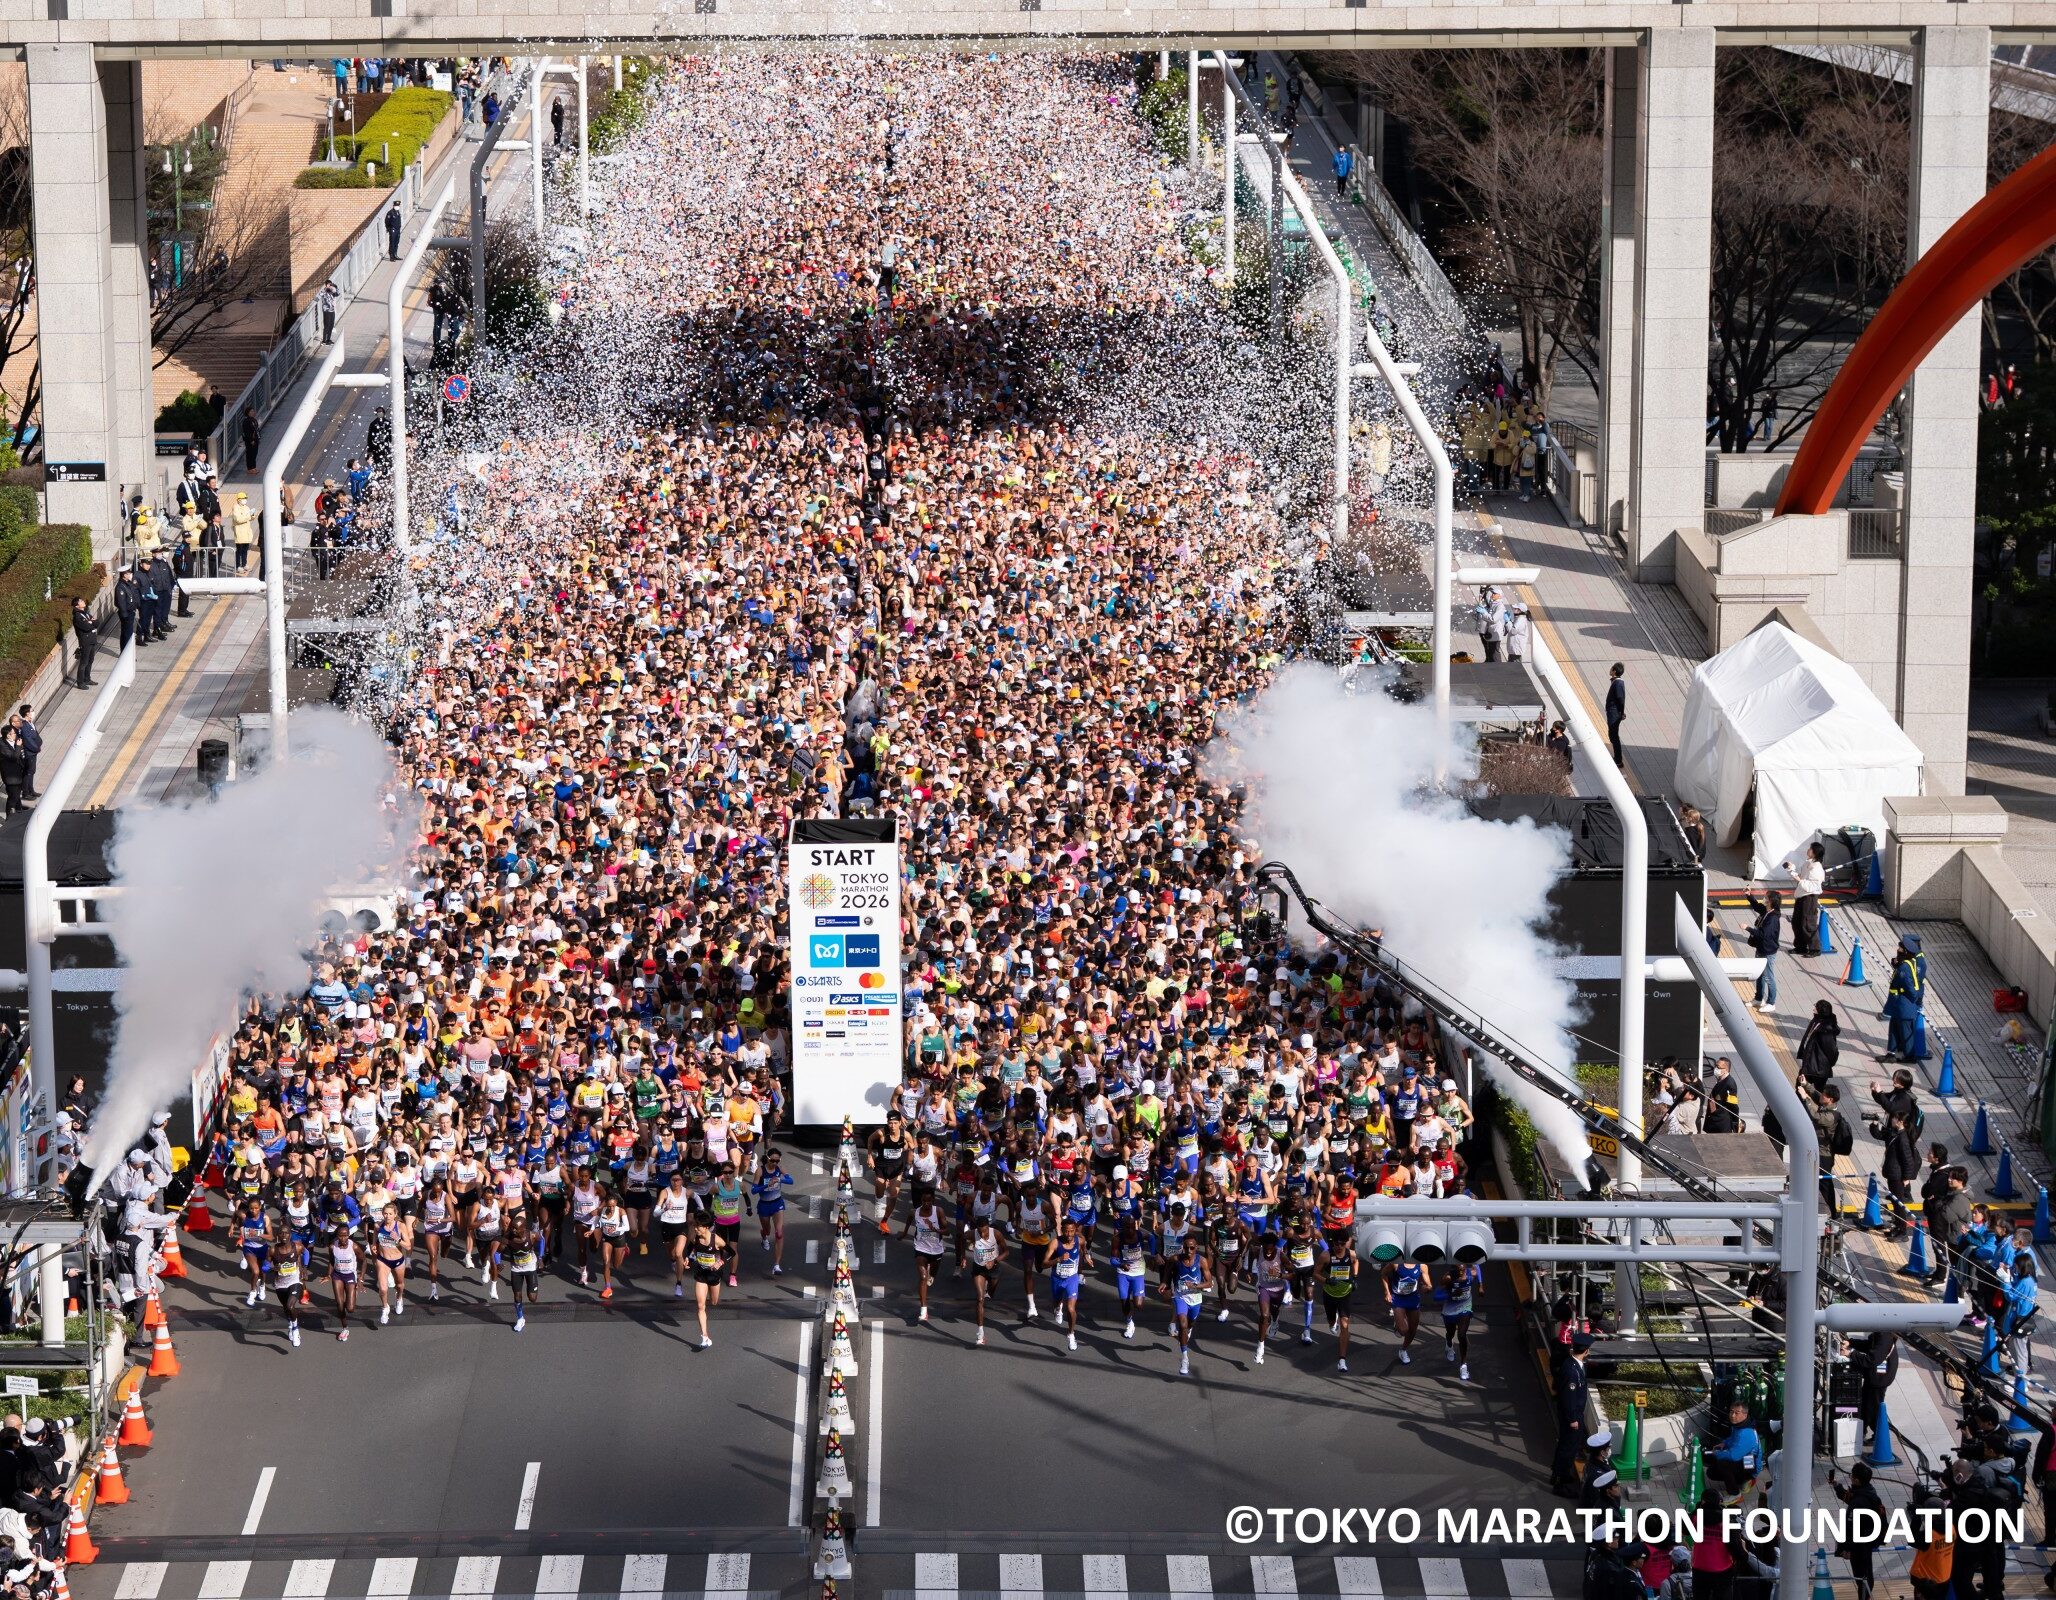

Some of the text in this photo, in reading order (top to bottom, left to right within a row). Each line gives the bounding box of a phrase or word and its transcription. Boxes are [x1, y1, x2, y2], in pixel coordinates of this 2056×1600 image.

[810, 849, 876, 867] START
[840, 873, 889, 884] TOKYO
[840, 885, 889, 893] MARATHON
[841, 894, 890, 909] 2026
[807, 976, 843, 987] STARTS
[1653, 990, 1671, 998] Own
[841, 995, 860, 1003] asics
[66, 1003, 89, 1012] Tokyo
[1589, 1135, 1617, 1154] IKO
[830, 1346, 851, 1355] TYO
[826, 1404, 848, 1413] TYO
[823, 1465, 845, 1473] TOKYO
